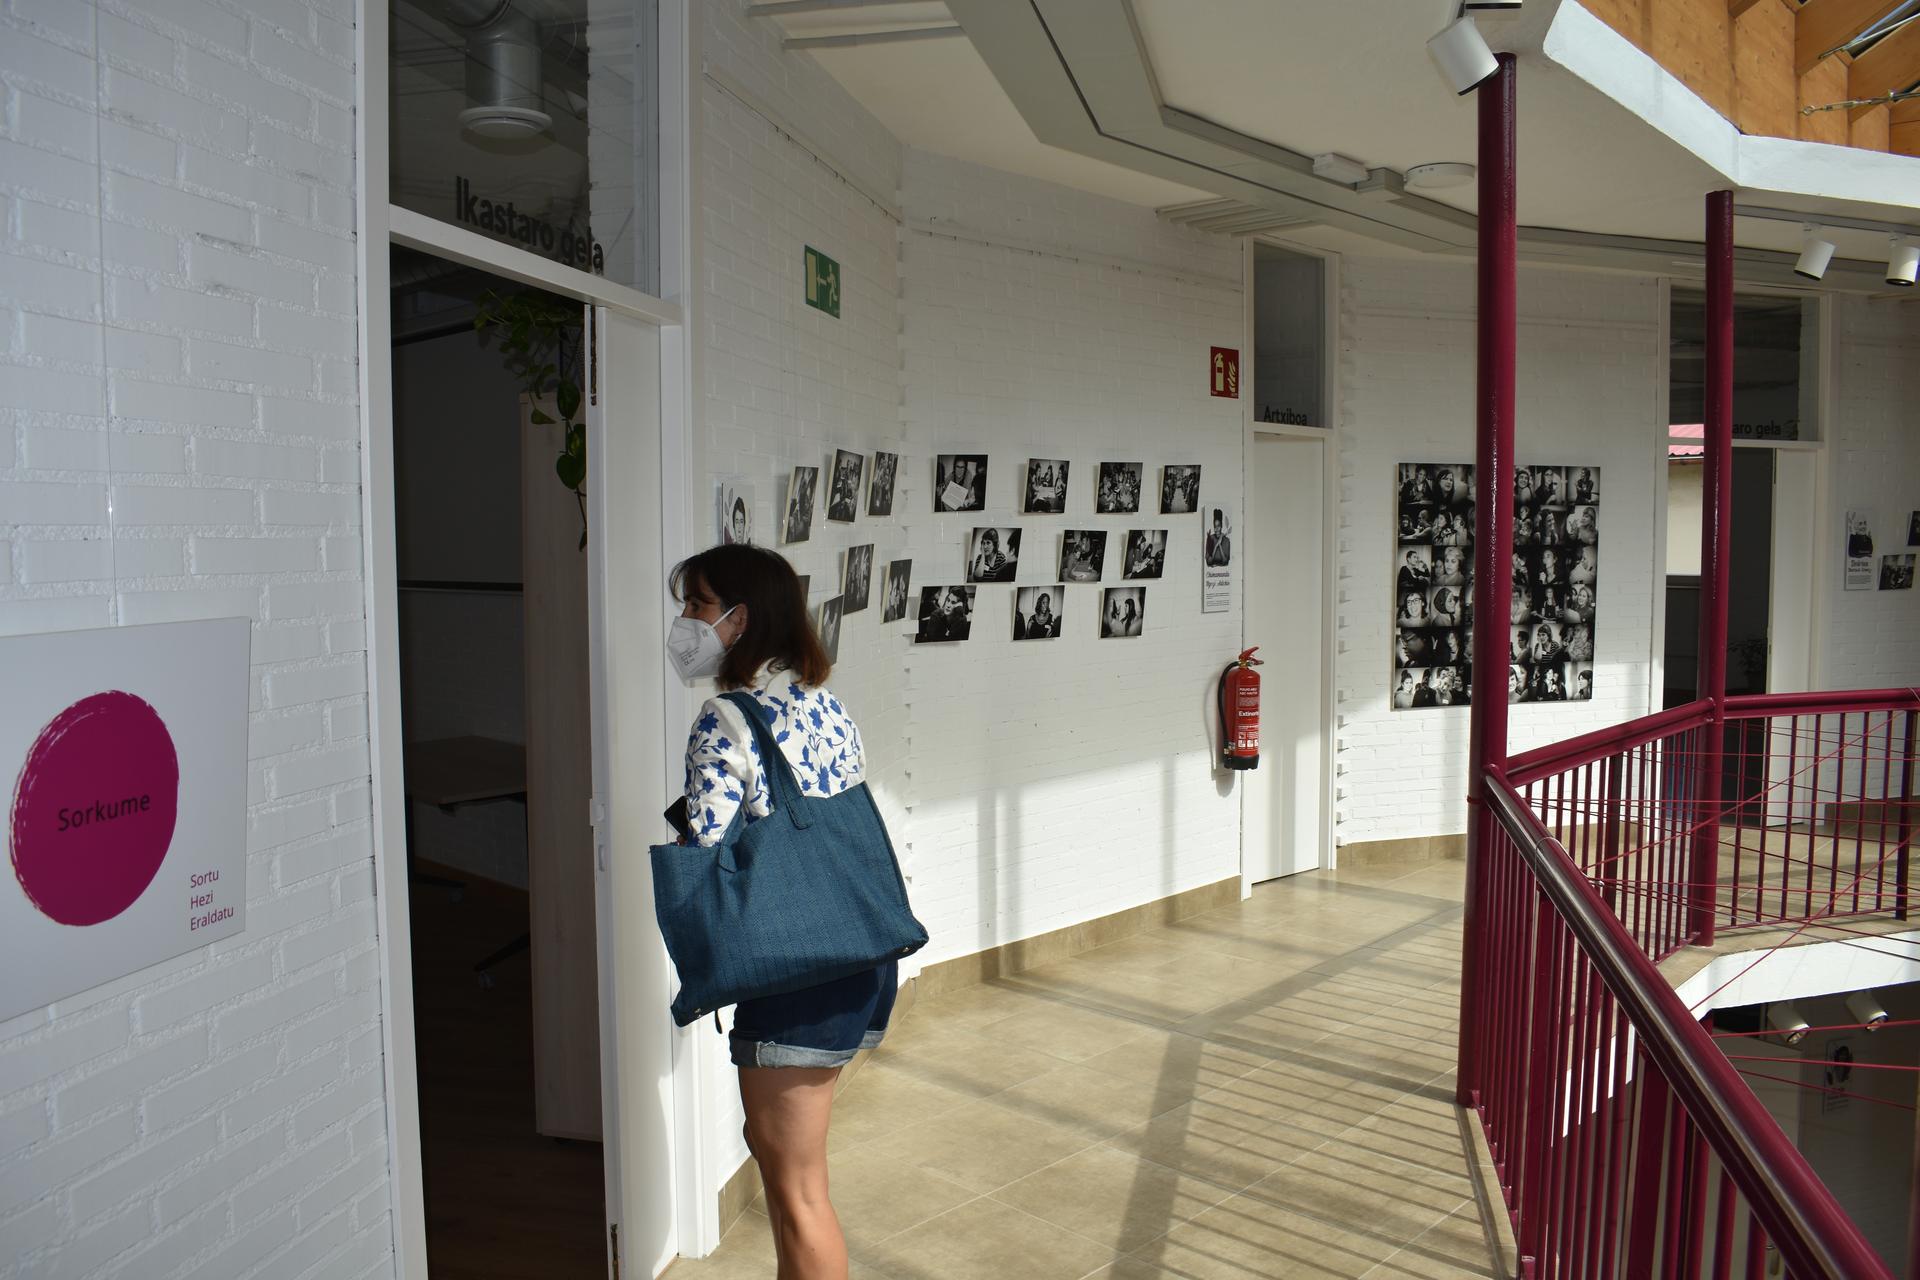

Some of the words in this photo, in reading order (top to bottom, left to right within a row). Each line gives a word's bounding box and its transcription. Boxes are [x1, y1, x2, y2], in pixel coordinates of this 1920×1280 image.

[456, 175, 554, 250] Ikastaro
[561, 226, 604, 276] gela
[1264, 405, 1308, 427] Artxiboa
[1732, 423, 1752, 434] aro
[1755, 420, 1781, 439] gela
[57, 793, 151, 832] Sorkume
[190, 869, 220, 889] Sortu
[190, 890, 214, 910] Hezi
[190, 906, 234, 931] Eraldatu
